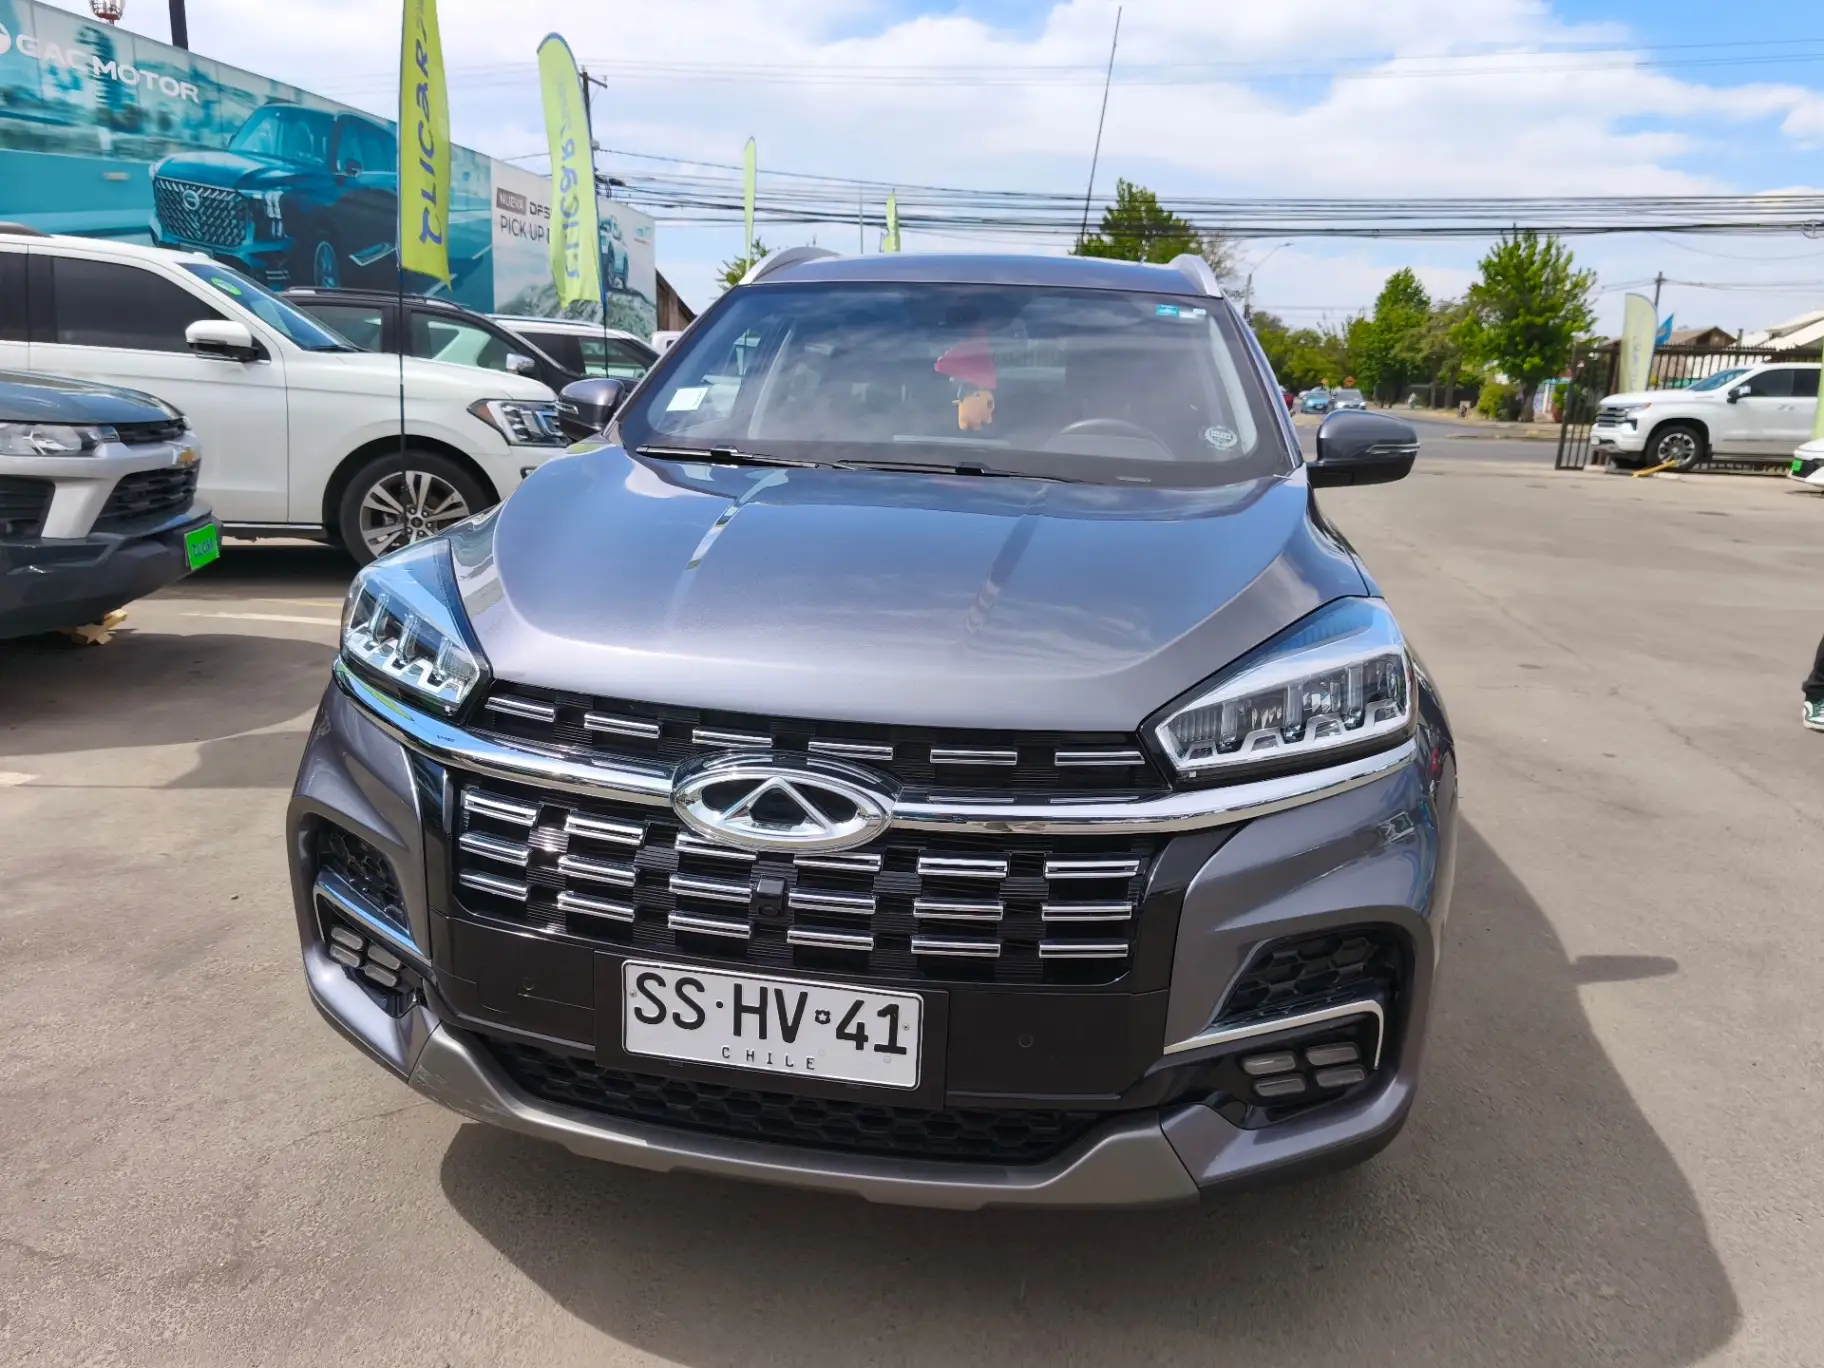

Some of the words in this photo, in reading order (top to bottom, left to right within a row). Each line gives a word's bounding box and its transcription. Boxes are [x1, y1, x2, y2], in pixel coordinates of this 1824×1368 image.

[15, 34, 90, 71] GAC
[92, 56, 200, 103] MOTOR
[500, 214, 527, 240] PICK
[720, 1045, 816, 1071] CHILE
